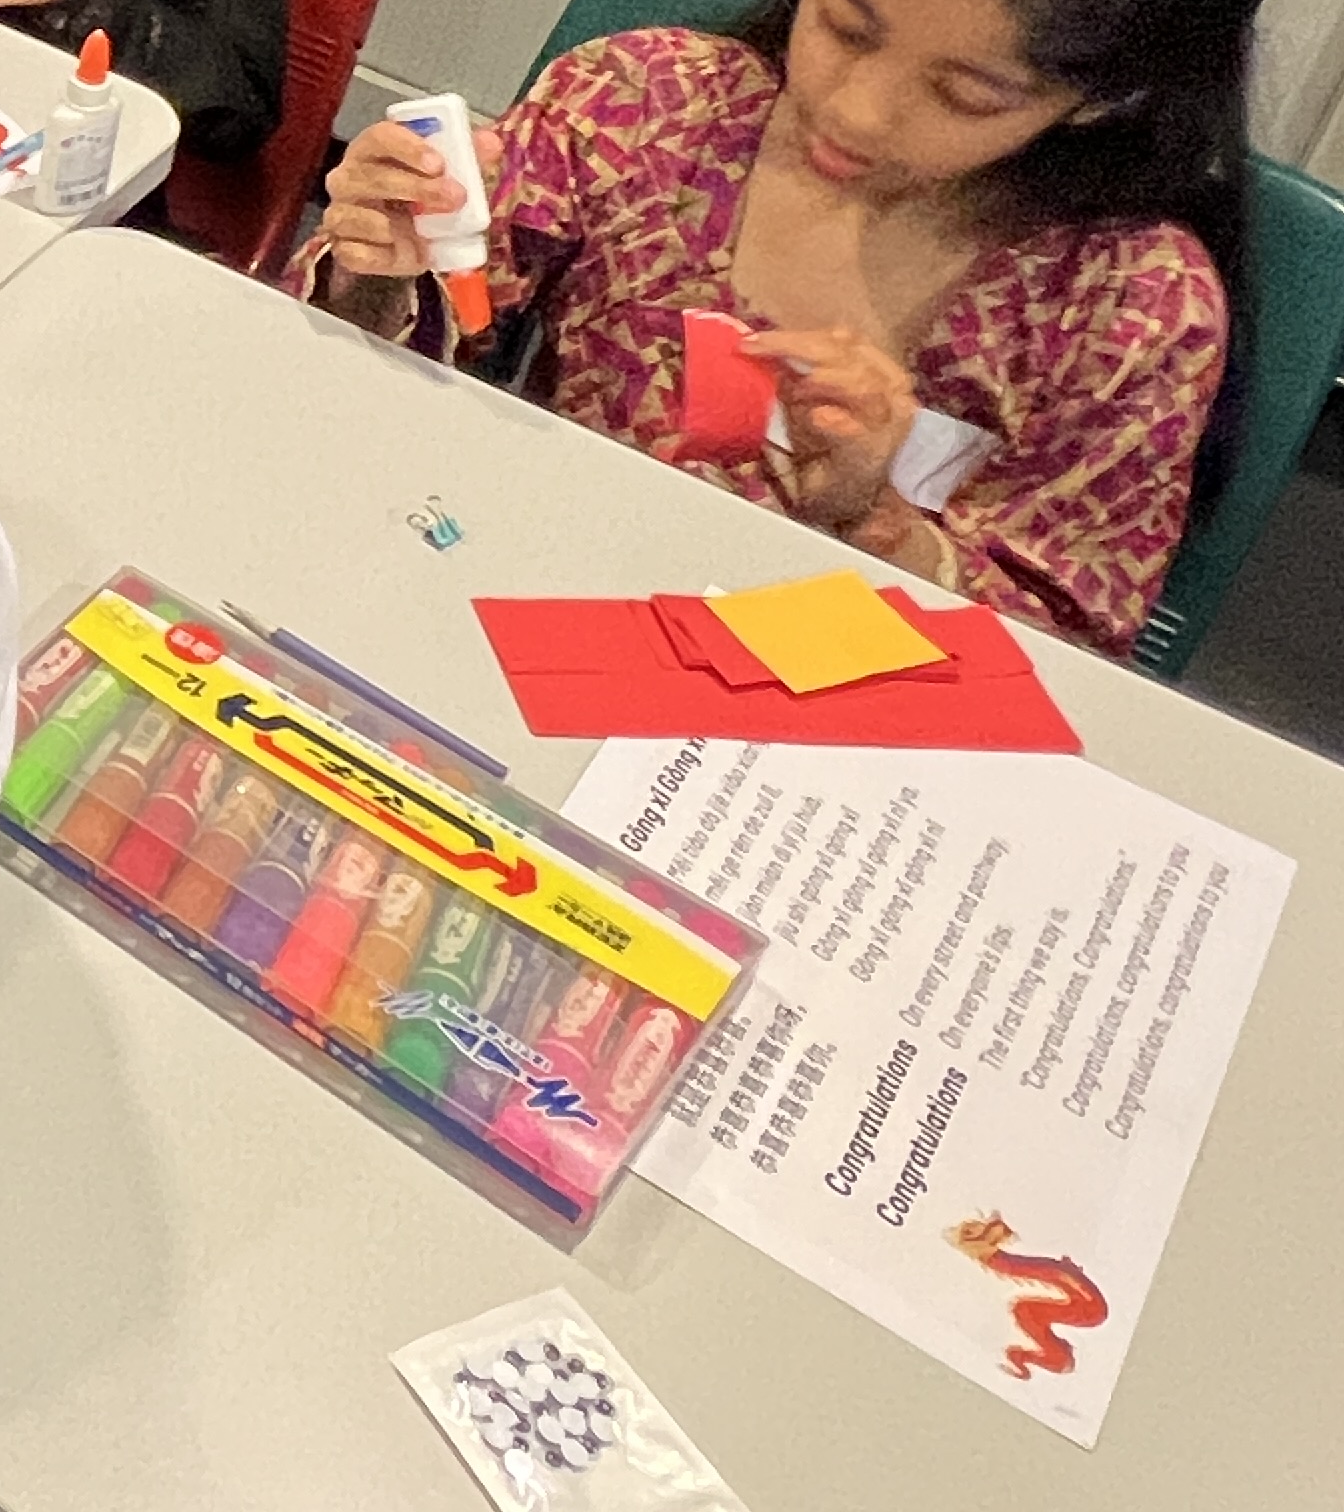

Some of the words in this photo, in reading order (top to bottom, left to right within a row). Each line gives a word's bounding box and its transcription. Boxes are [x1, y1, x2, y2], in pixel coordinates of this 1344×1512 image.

[176, 672, 208, 698] 12
[1166, 842, 1191, 876] you
[1204, 860, 1231, 896] you
[1007, 968, 1047, 1011] thing
[992, 1006, 1026, 1044] first
[977, 1038, 1010, 1072] The
[824, 1038, 918, 1197] Congratulations
[876, 1066, 968, 1228] Congratulations
